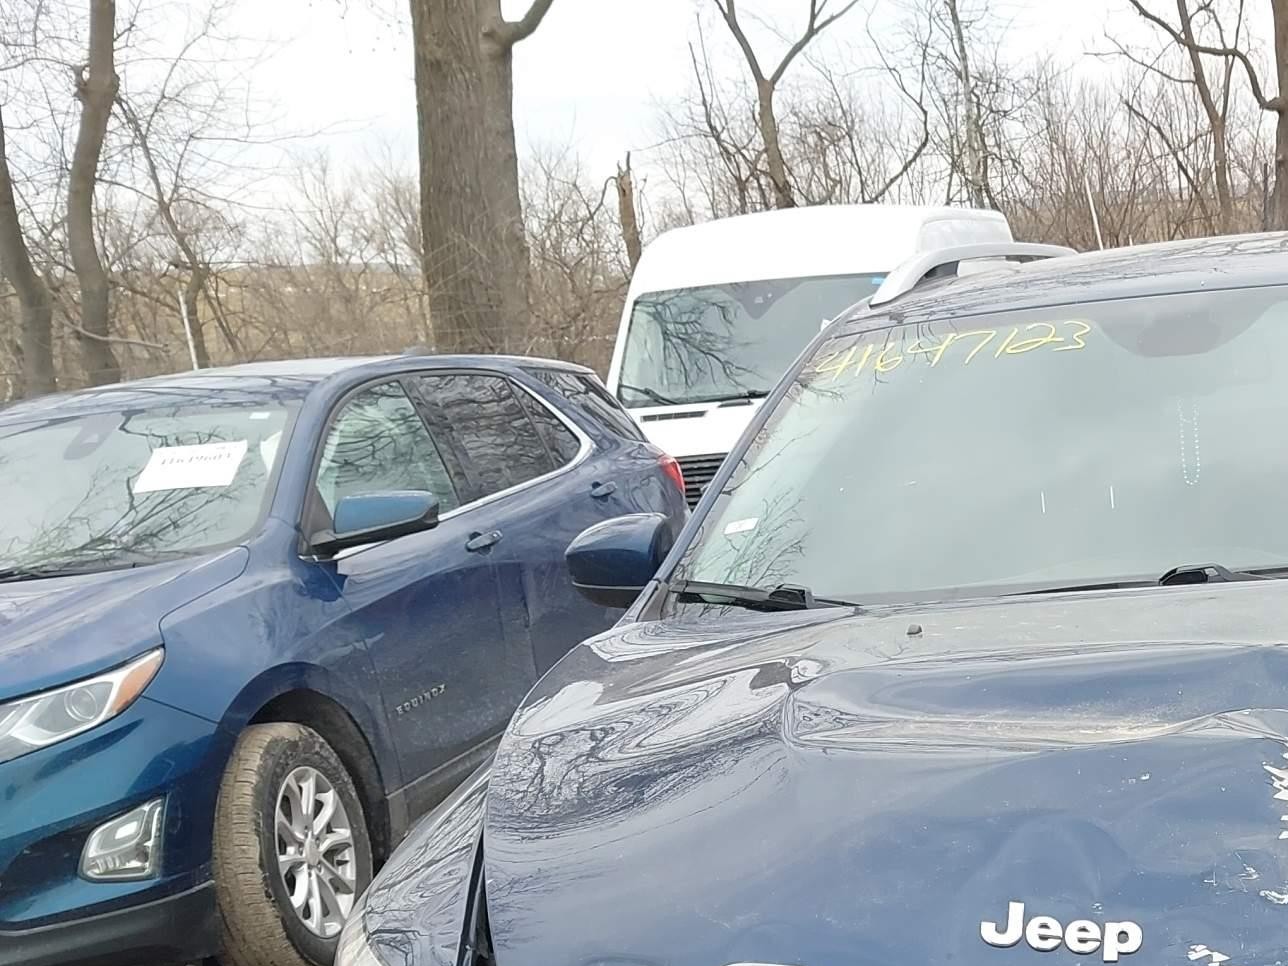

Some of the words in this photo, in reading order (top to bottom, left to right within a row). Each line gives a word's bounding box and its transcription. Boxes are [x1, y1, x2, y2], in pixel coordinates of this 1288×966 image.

[815, 321, 1091, 383] 41647123
[395, 683, 446, 715] EQUINOX
[980, 900, 1143, 963] Jeep
